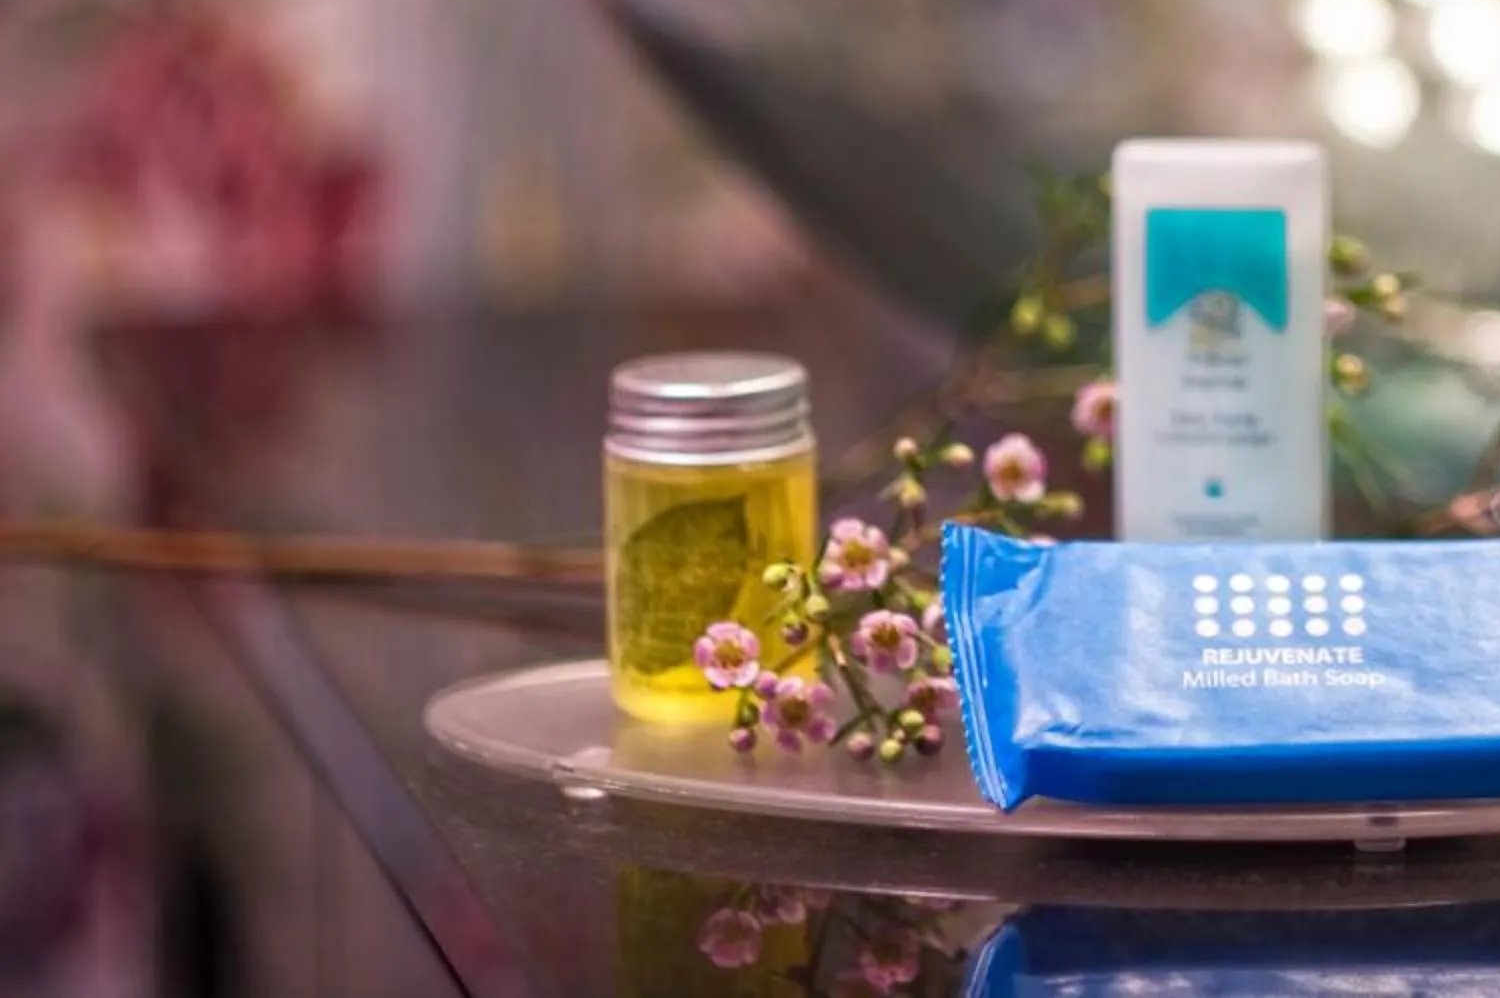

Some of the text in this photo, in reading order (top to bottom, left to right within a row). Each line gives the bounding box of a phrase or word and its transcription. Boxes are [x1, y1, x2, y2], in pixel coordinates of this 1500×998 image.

[1202, 647, 1364, 664] REJUVENATE
[1183, 669, 1384, 688] Milled Bath Soap
